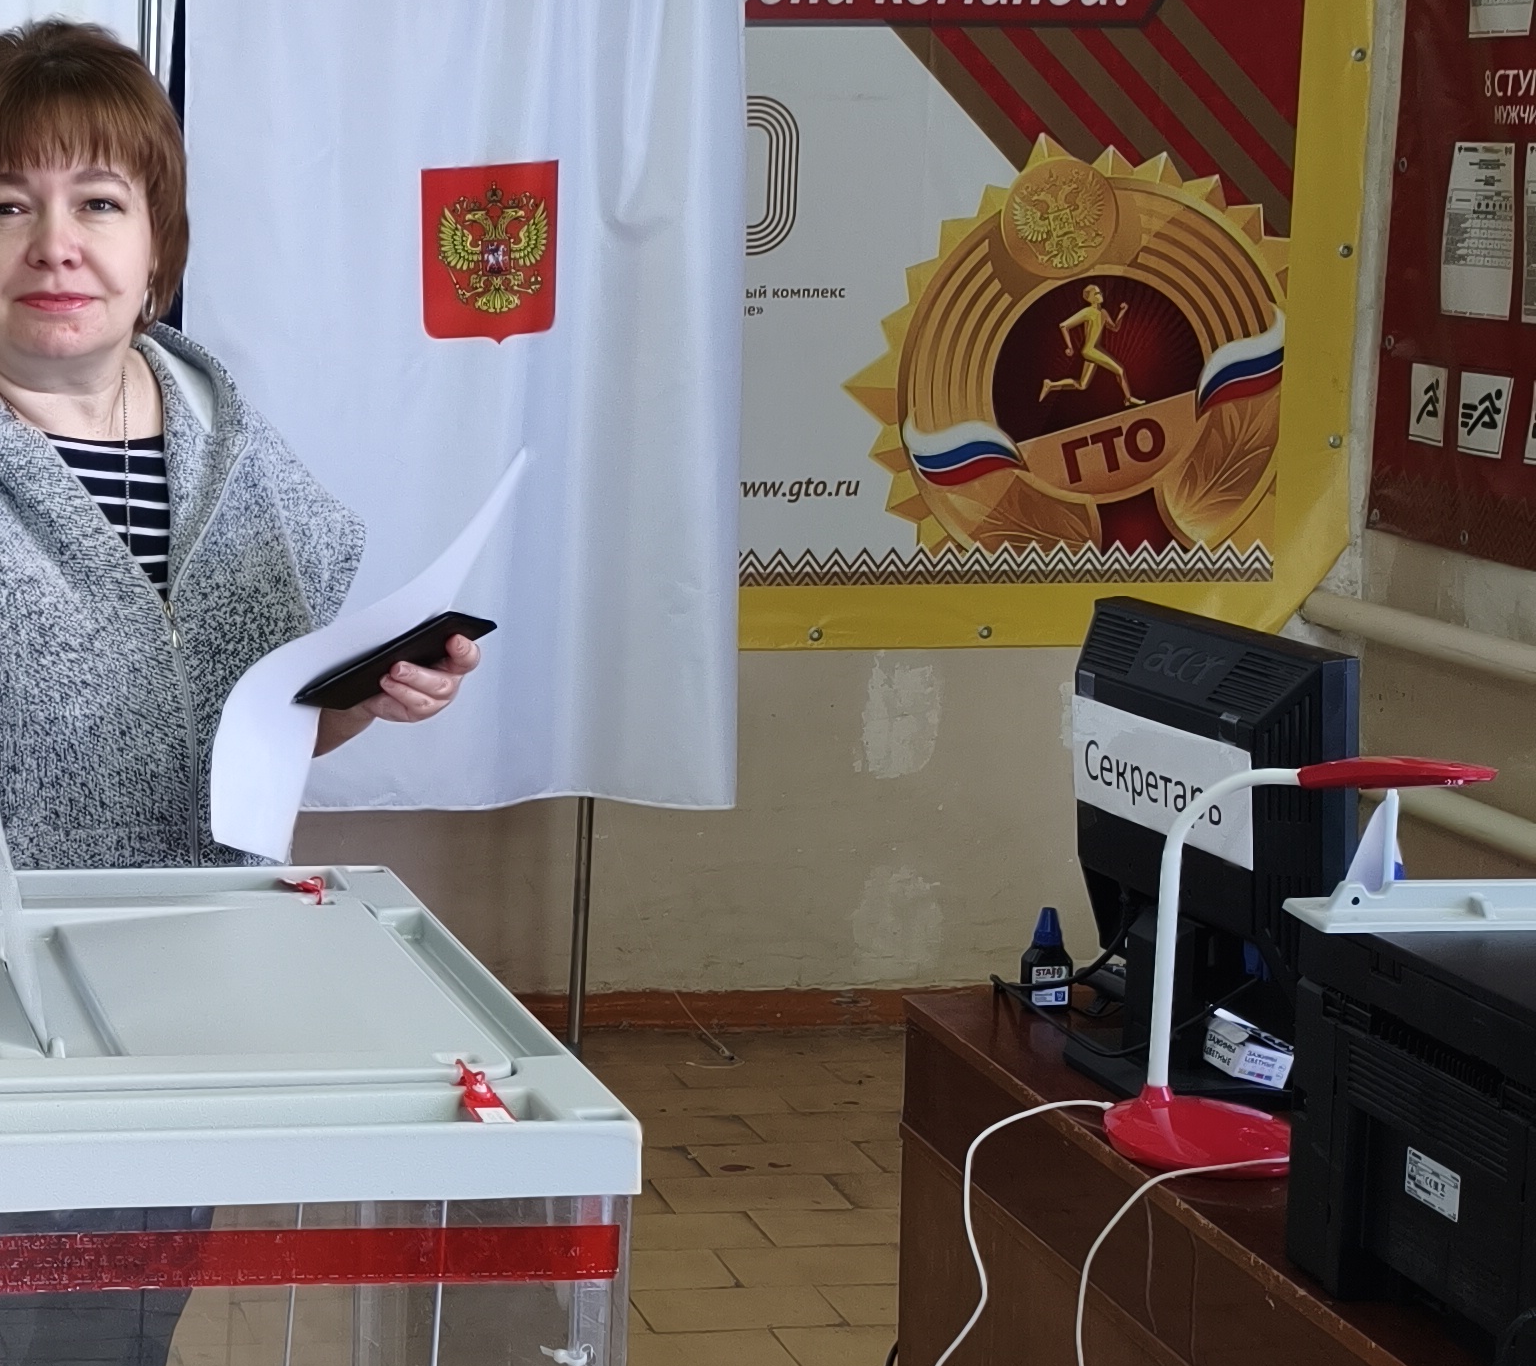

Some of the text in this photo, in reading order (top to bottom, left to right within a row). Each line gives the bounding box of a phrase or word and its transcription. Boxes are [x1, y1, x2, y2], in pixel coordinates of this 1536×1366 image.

[772, 287, 846, 300] комплекс
[1060, 417, 1168, 485] ГТО
[740, 477, 860, 503] ww.gto.ru
[1143, 640, 1225, 686] acer
